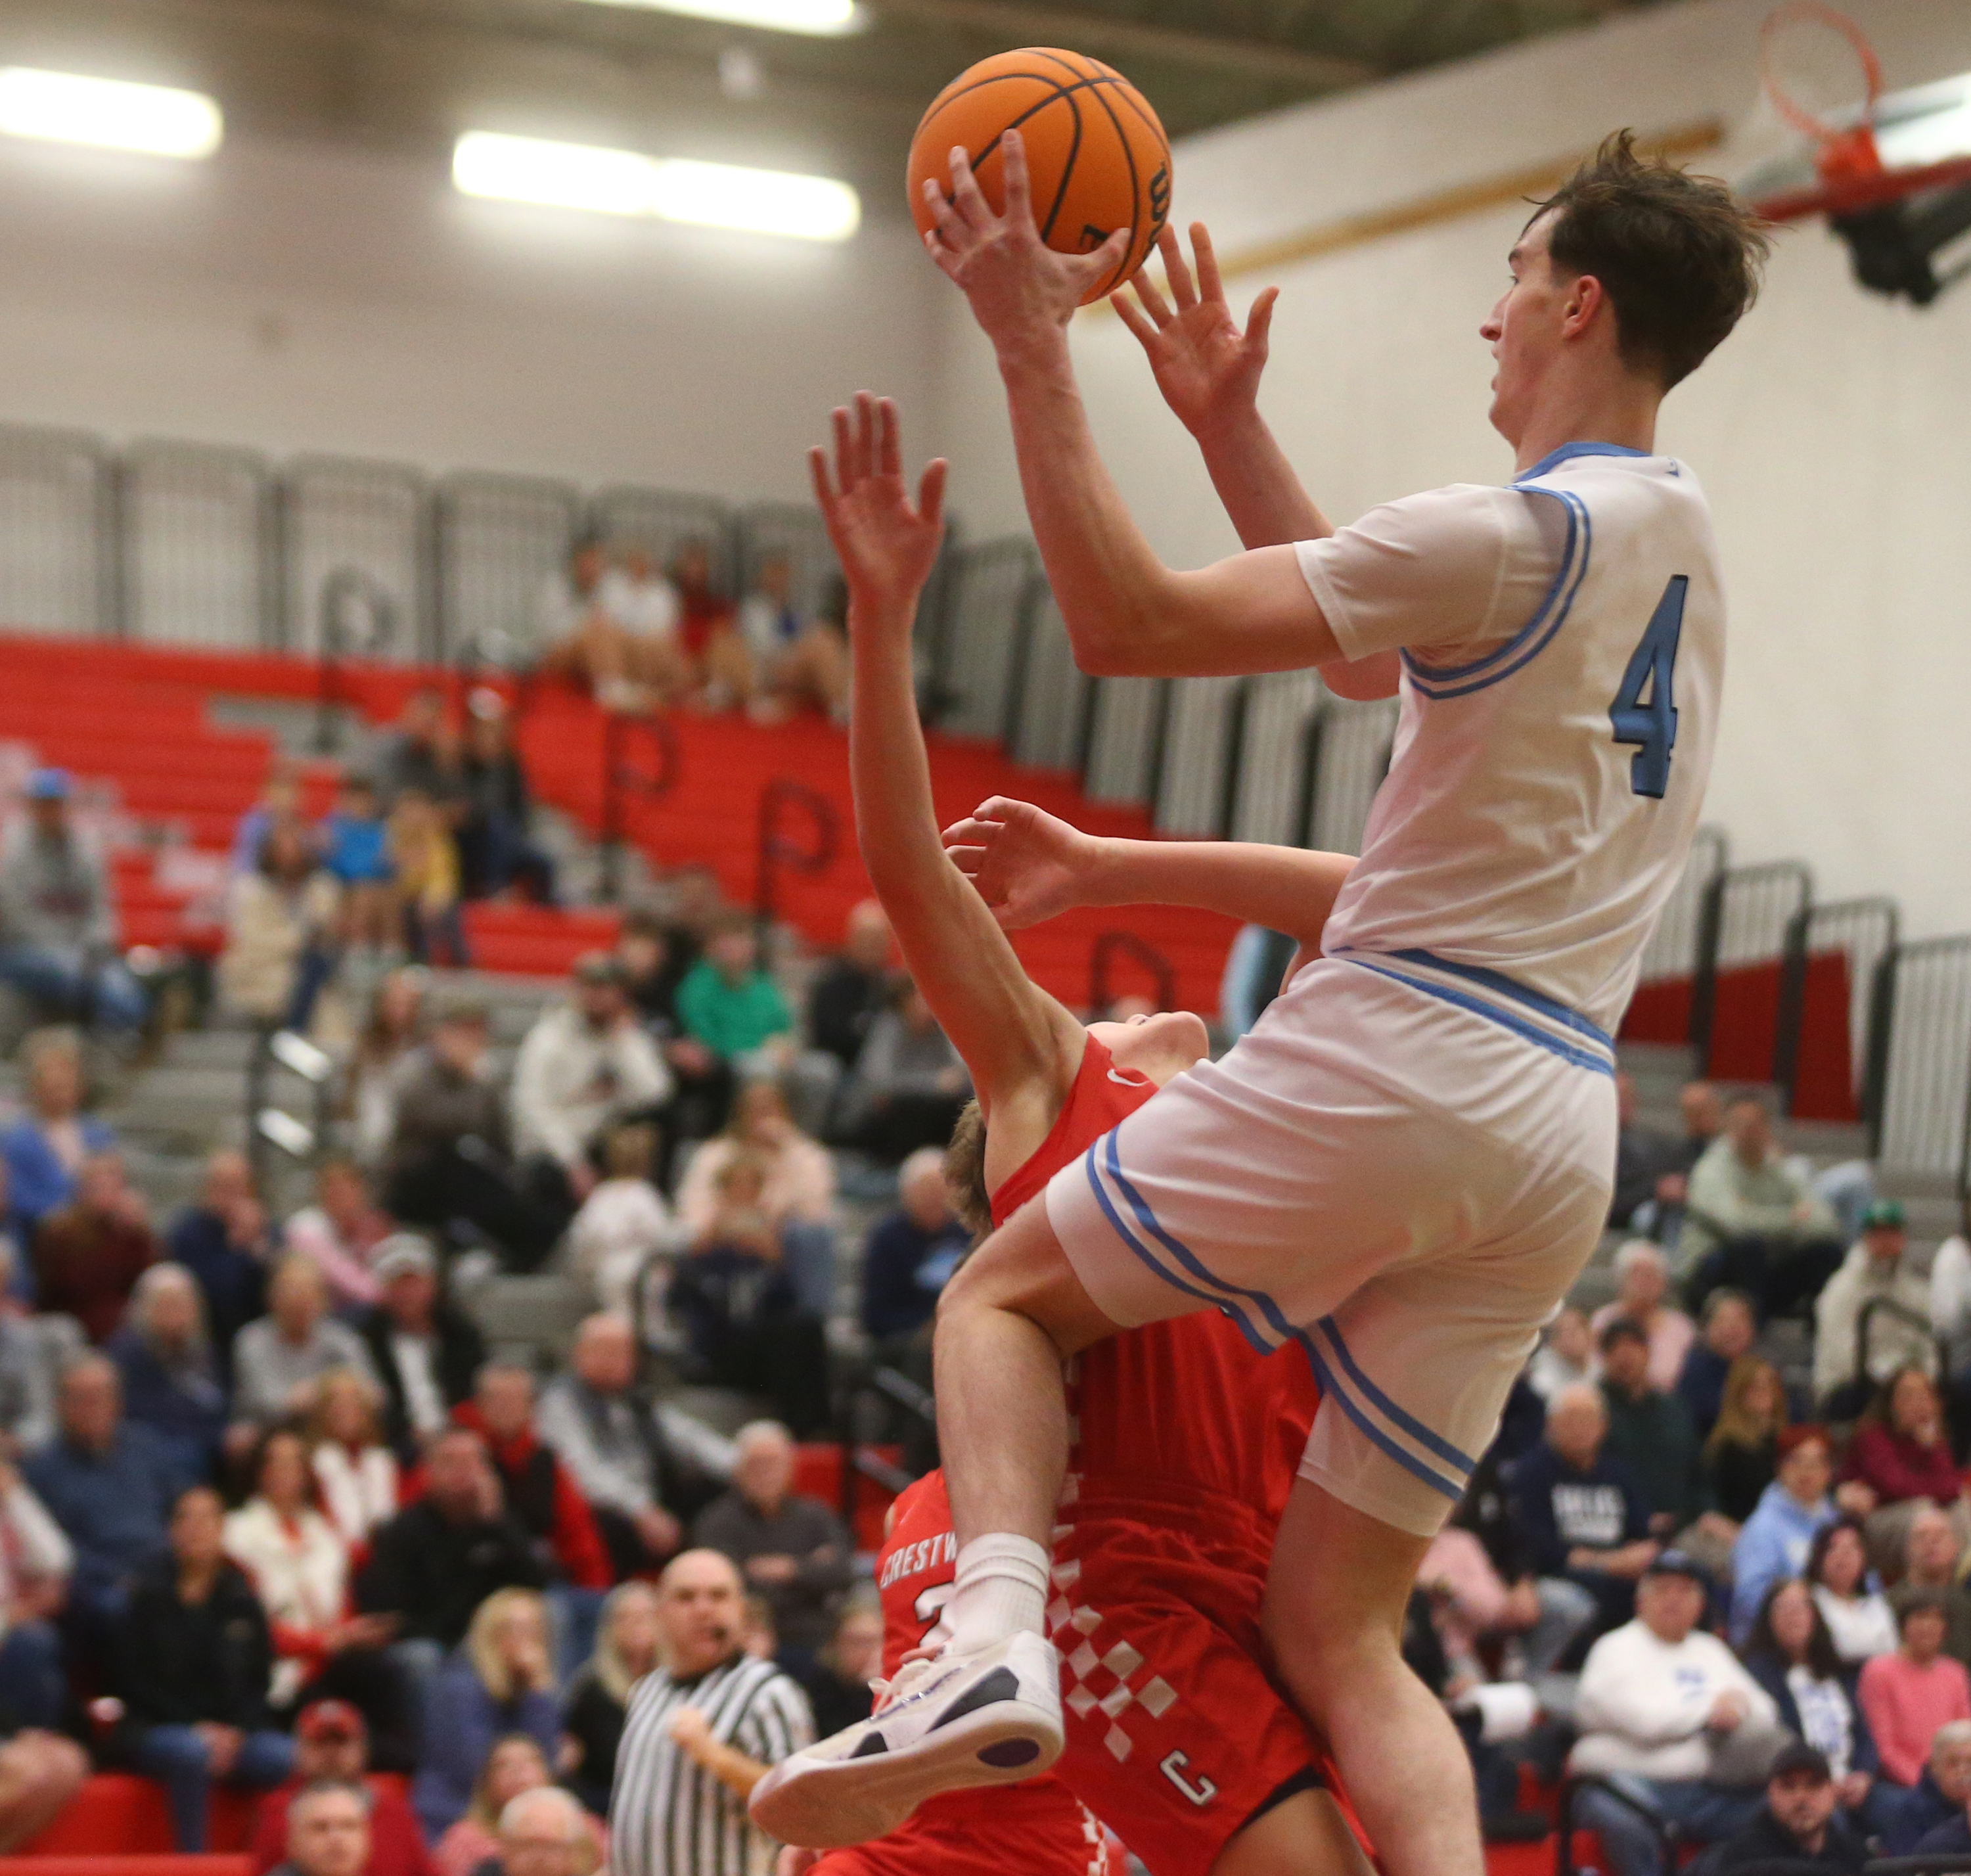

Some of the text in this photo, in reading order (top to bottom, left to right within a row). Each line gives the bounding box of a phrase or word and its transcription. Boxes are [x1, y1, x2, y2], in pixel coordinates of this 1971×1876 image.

[1609, 568, 1688, 799] 4
[880, 1530, 957, 1589] CRESTW
[1159, 1749, 1217, 1806] C
